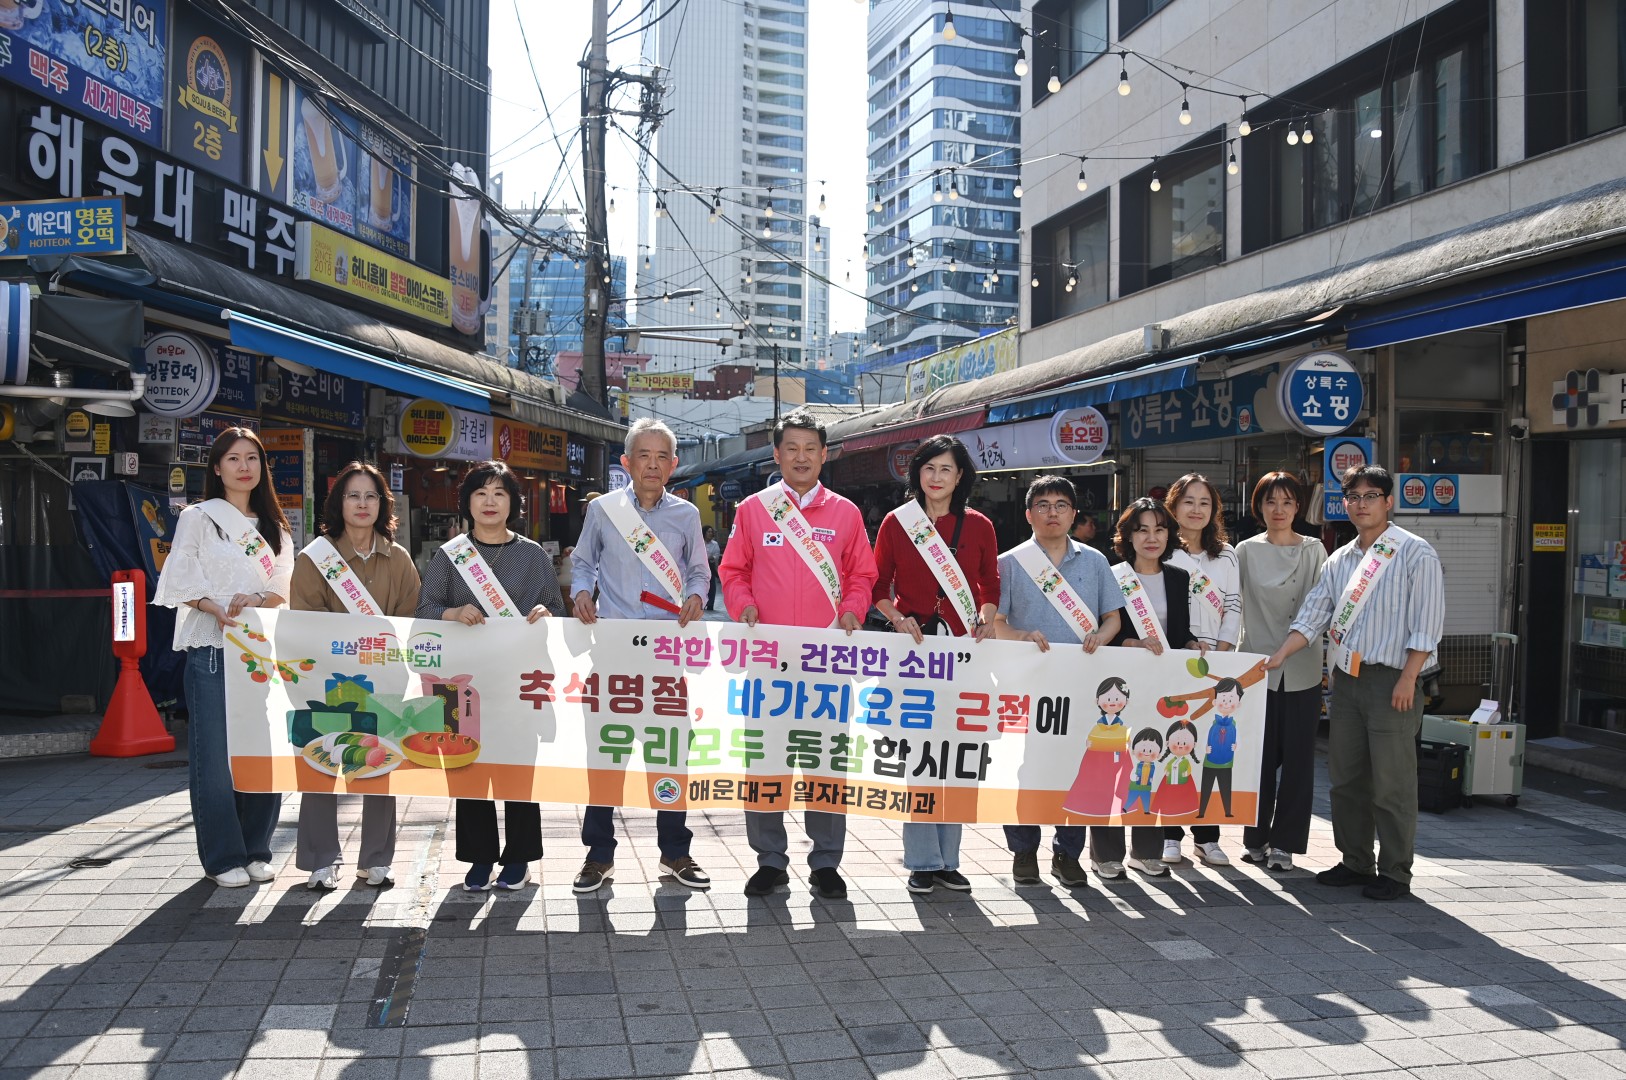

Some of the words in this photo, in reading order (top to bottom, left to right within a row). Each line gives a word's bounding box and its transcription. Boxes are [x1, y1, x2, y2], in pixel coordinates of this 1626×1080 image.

[84, 25, 128, 72] (2층)
[28, 48, 69, 94] 맥주
[83, 76, 152, 133] 세계맥주
[191, 93, 207, 109] SOJU
[212, 104, 228, 119] BEER
[193, 121, 223, 160] 2층
[29, 105, 195, 243] 해운대
[223, 188, 296, 276] 맥주
[28, 211, 71, 236] 해운대
[76, 208, 114, 225] 명품
[309, 197, 325, 216] 맥주
[326, 204, 353, 230] 세계맥주
[29, 238, 71, 248] HOTTEOK
[76, 227, 114, 245] 호떡
[315, 248, 332, 264] SINCE
[315, 259, 332, 276] 2018
[352, 256, 388, 289] 허니홈비
[391, 271, 444, 309] 벌집아이스크림
[451, 265, 479, 294] 홍스비어
[156, 345, 185, 356] 해운대
[224, 350, 251, 384] 호떡
[146, 386, 190, 396] HOTTEOK
[288, 372, 345, 404] 홍스비어
[642, 376, 691, 388] 가마치통닭
[1304, 376, 1348, 390] 상록수
[1127, 391, 1182, 439] 상록수
[1191, 380, 1233, 429] 쇼핑
[1302, 395, 1350, 420] 쇼핑
[406, 434, 446, 446] 아이스크림
[413, 419, 441, 435] 벌집
[460, 416, 487, 446] 막걸리
[1060, 422, 1103, 444] 불오뎅
[1335, 454, 1362, 470] 담배
[1405, 485, 1424, 496] 담배
[1435, 485, 1453, 496] 담배
[801, 536, 825, 563] 추석명절
[813, 534, 833, 542] 김성수
[941, 563, 962, 591] 추석명절
[481, 582, 506, 610] 추석명절
[331, 636, 387, 655] 일상행복
[414, 638, 442, 653] 해운대
[632, 635, 714, 668] “착한
[721, 638, 788, 672] 가격,
[800, 643, 889, 677] 건전한
[898, 650, 971, 681] 소비”
[519, 669, 704, 721] 추석명절,
[727, 678, 936, 729] 바가지요금
[956, 692, 1070, 735] 근절에
[598, 724, 766, 768] 우리모두
[786, 729, 992, 781] 동참합시다
[689, 779, 782, 804] 해운대구
[793, 780, 936, 814] 일자리경제과
